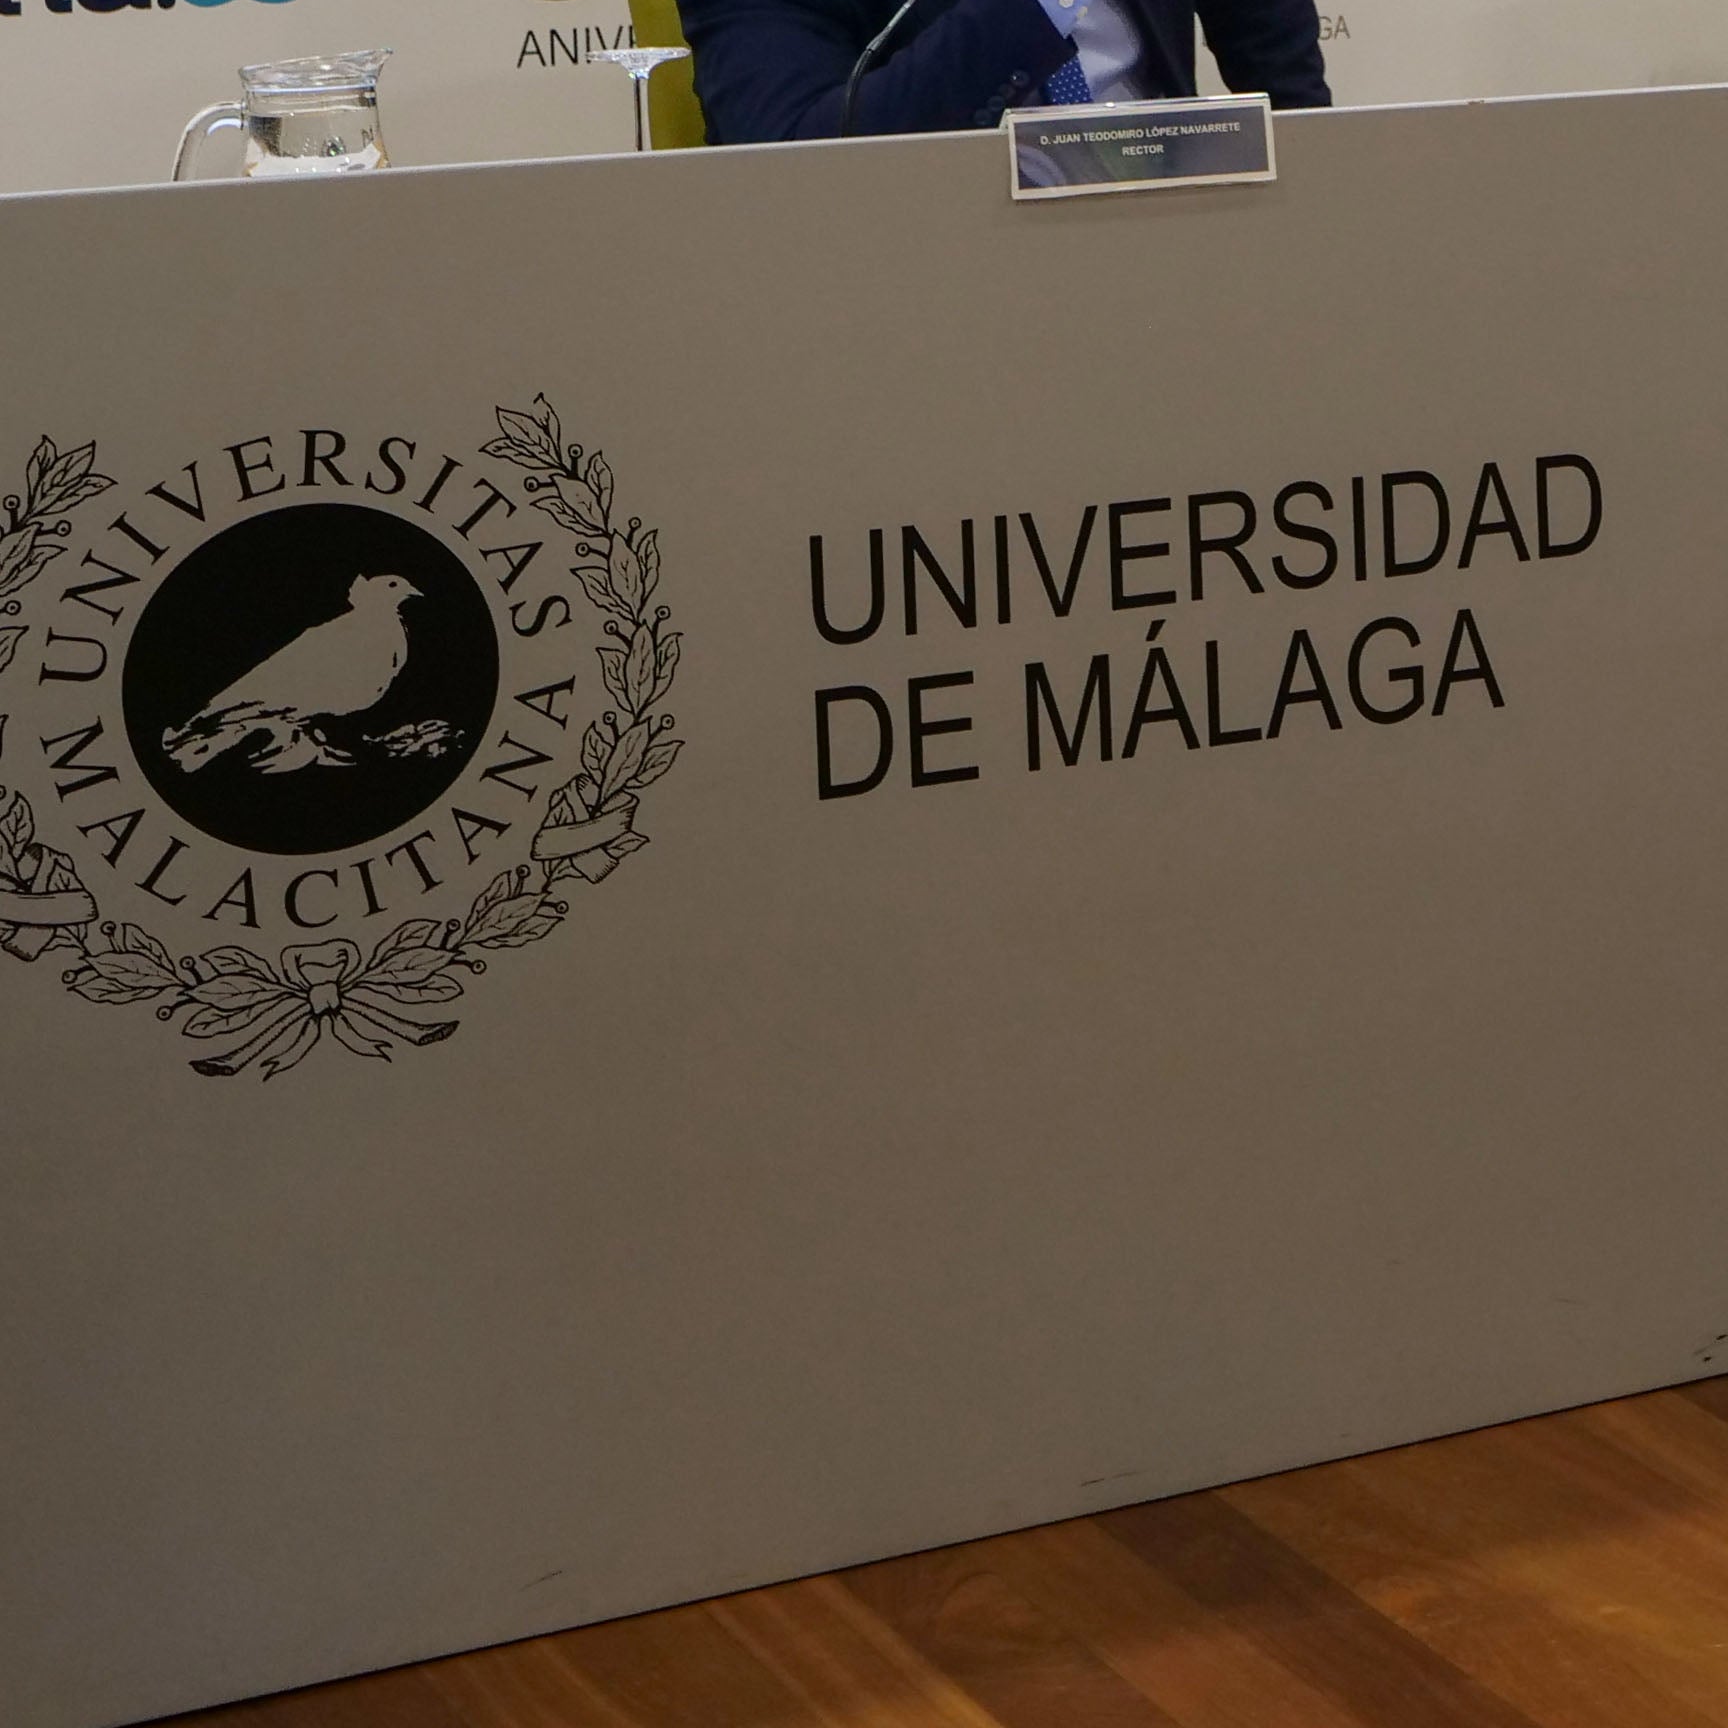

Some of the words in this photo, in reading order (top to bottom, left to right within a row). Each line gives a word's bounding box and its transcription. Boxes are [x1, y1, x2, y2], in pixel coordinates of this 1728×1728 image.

[1040, 135, 1051, 146] D.
[1053, 133, 1081, 145] JUAN
[1084, 129, 1144, 142] TEODOMIRO
[1146, 125, 1179, 138] LÓPEZ
[1180, 122, 1240, 135] NAVARRETE
[1122, 144, 1164, 156] RECTOR
[40, 428, 575, 686] UNIVERSITAS
[809, 454, 1602, 645] UNIVERSIDAD
[815, 671, 980, 800] DE
[1025, 608, 1506, 772] MÁLAGA
[40, 672, 577, 929] MALACITANA
